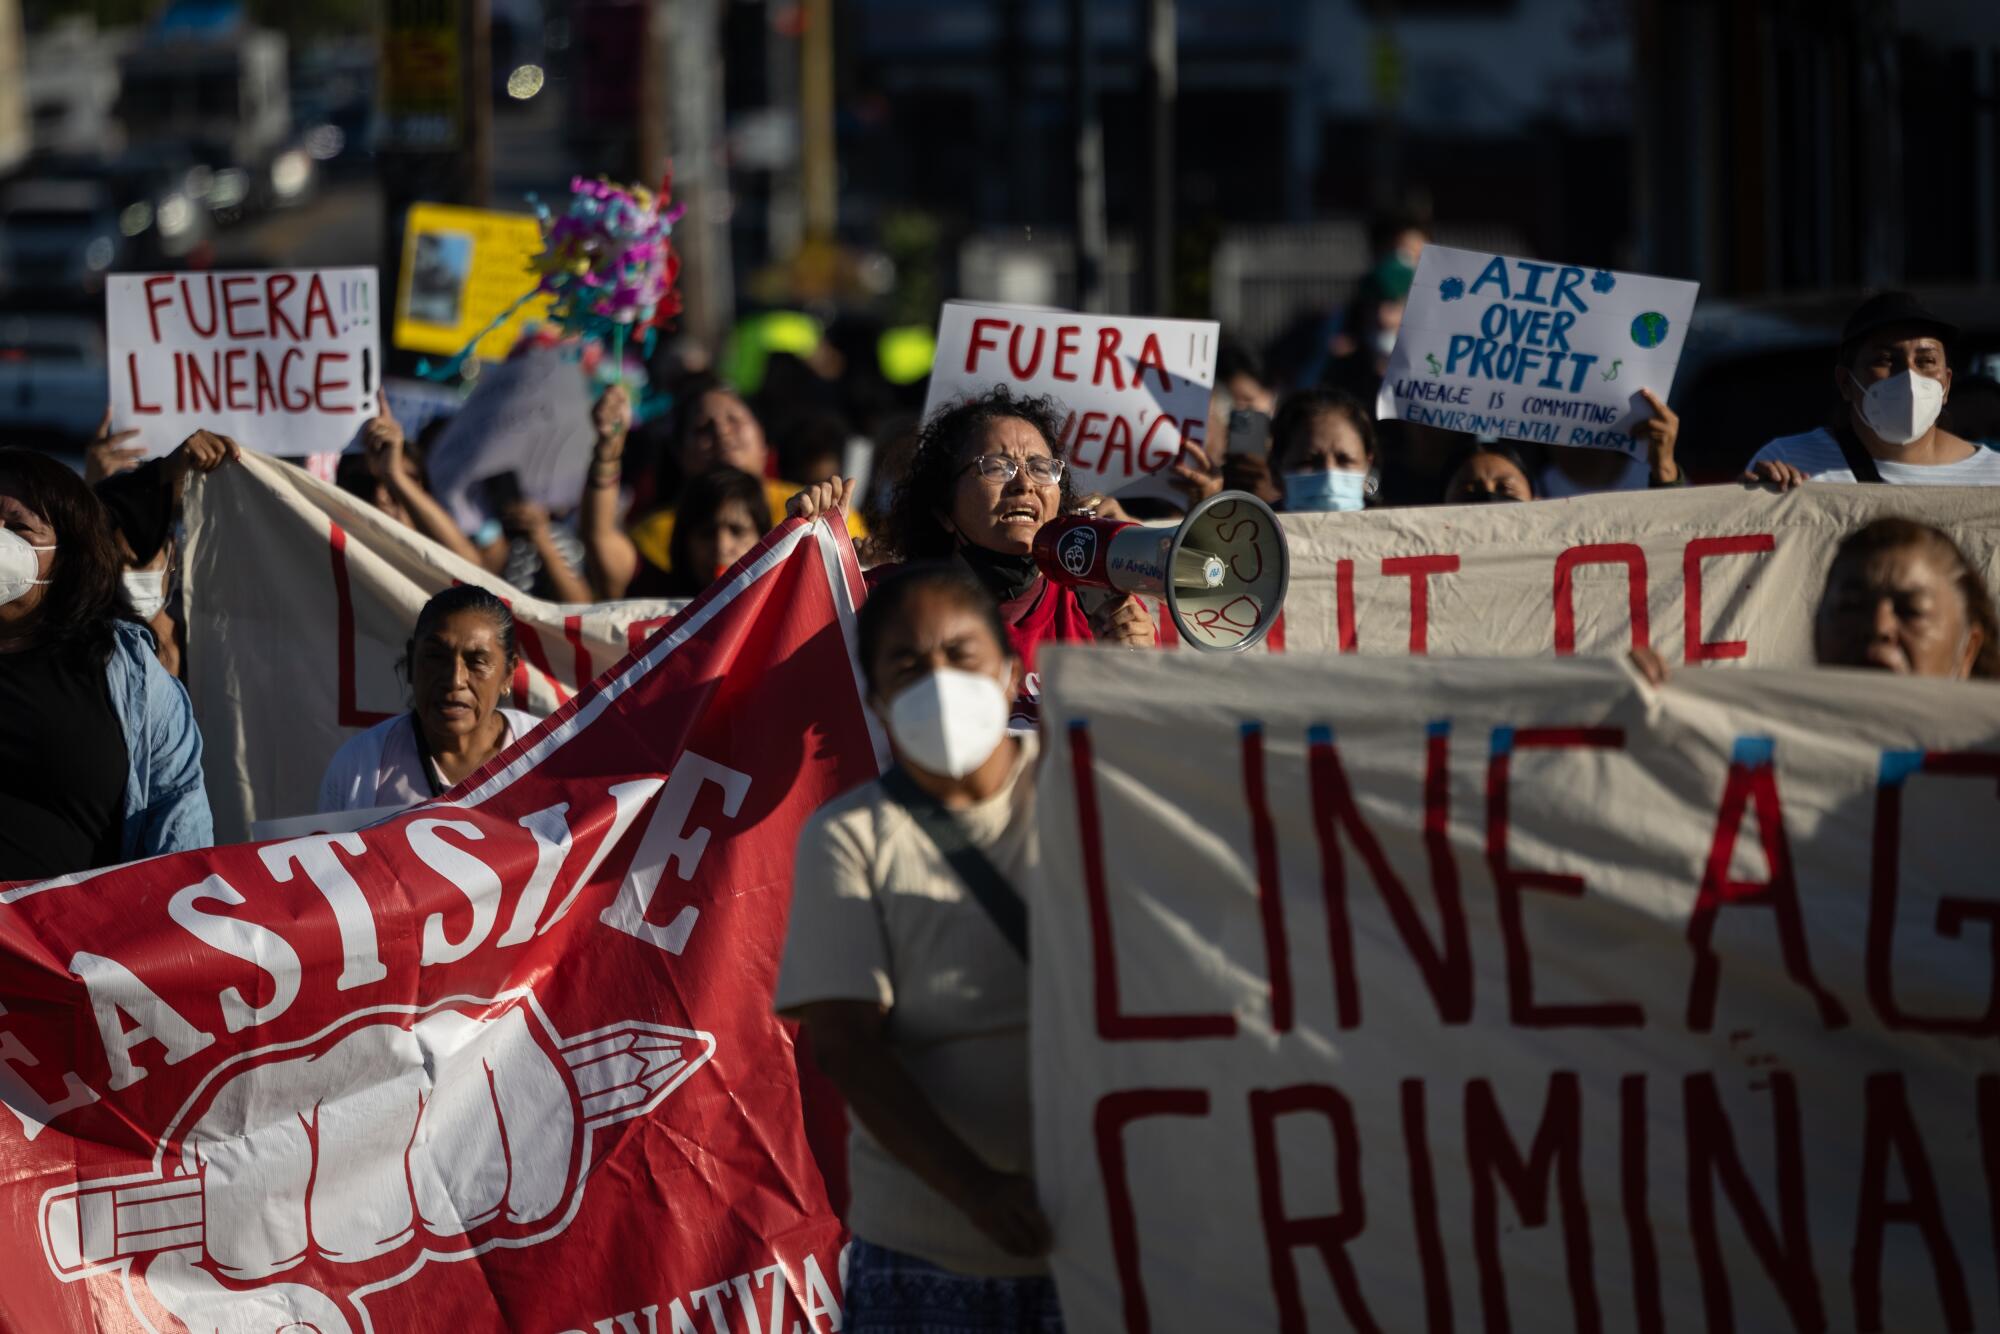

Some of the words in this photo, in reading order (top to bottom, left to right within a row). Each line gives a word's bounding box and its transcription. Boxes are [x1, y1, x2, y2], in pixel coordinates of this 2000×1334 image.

[1469, 257, 1588, 313] AIR
[1480, 303, 1576, 351] OVER
[128, 348, 371, 415] LINEAGE!
[1445, 334, 1598, 394] PROFIT
[1396, 379, 1472, 405] LINEAGE
[1488, 391, 1505, 410] IS
[1522, 396, 1618, 425] COMMITTING
[1406, 404, 1562, 442] ENVIRONMENTAL
[1570, 426, 1637, 451] RACISM
[1057, 409, 1204, 477] EAGE
[1094, 1071, 2000, 1334] CRIMINA
